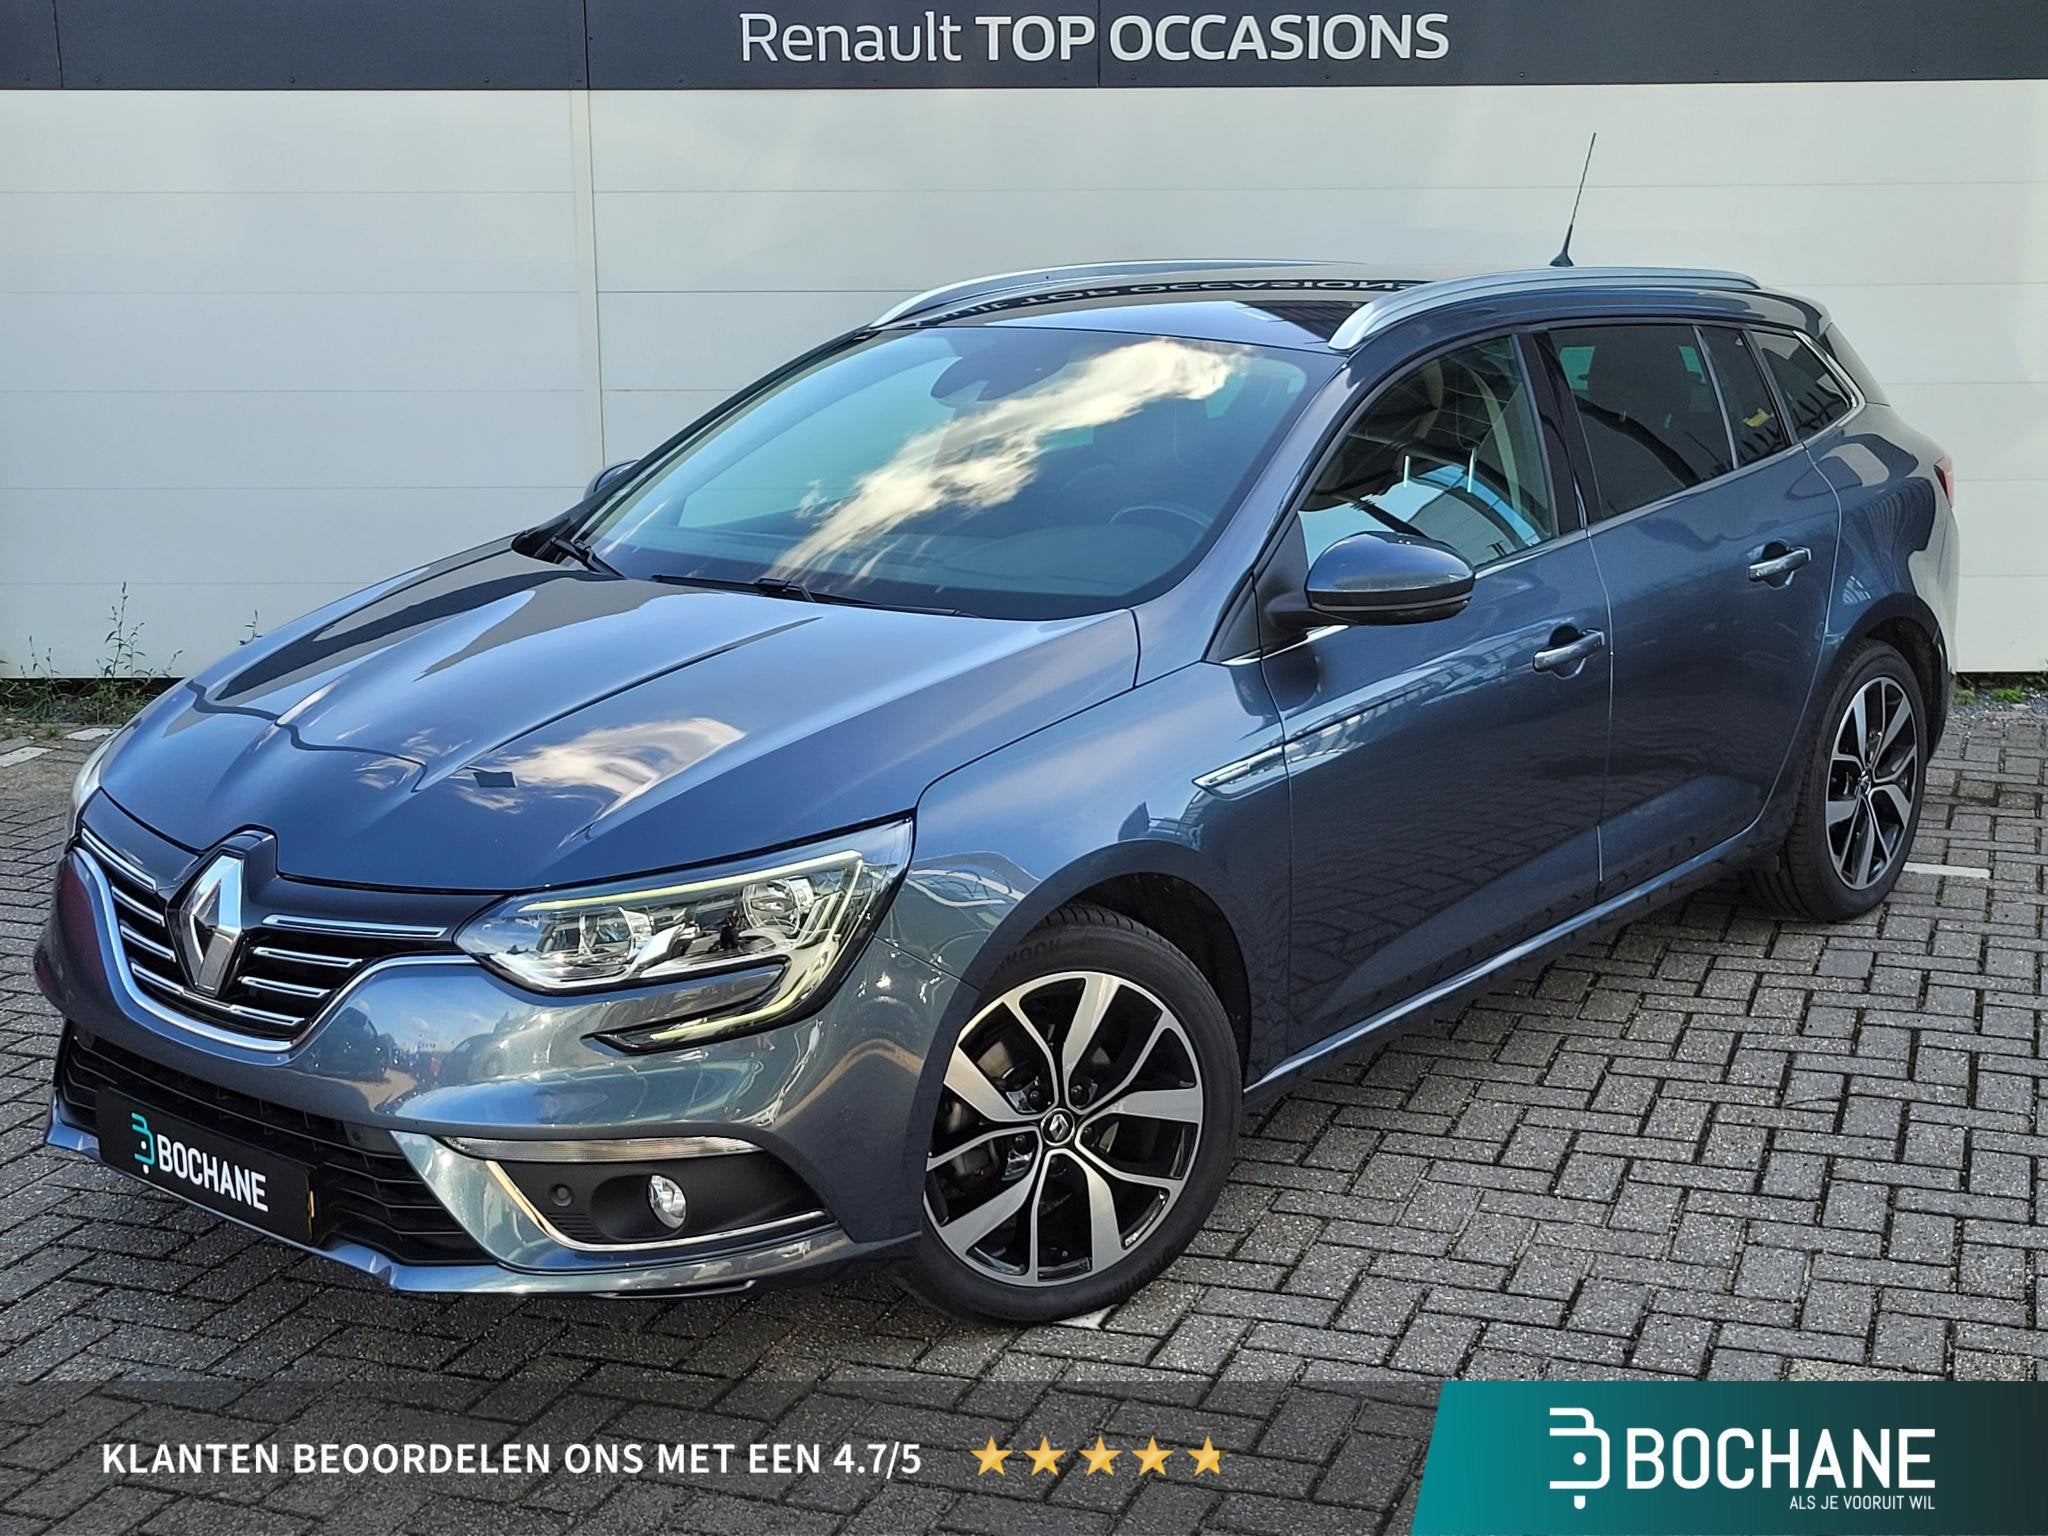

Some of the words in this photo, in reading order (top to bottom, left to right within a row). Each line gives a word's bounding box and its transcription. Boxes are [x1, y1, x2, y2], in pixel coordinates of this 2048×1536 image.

[739, 11, 963, 62] Renault
[975, 15, 1096, 61] TOP
[1109, 13, 1449, 61] OCCASIONS
[156, 1133, 270, 1213] BOCHANE
